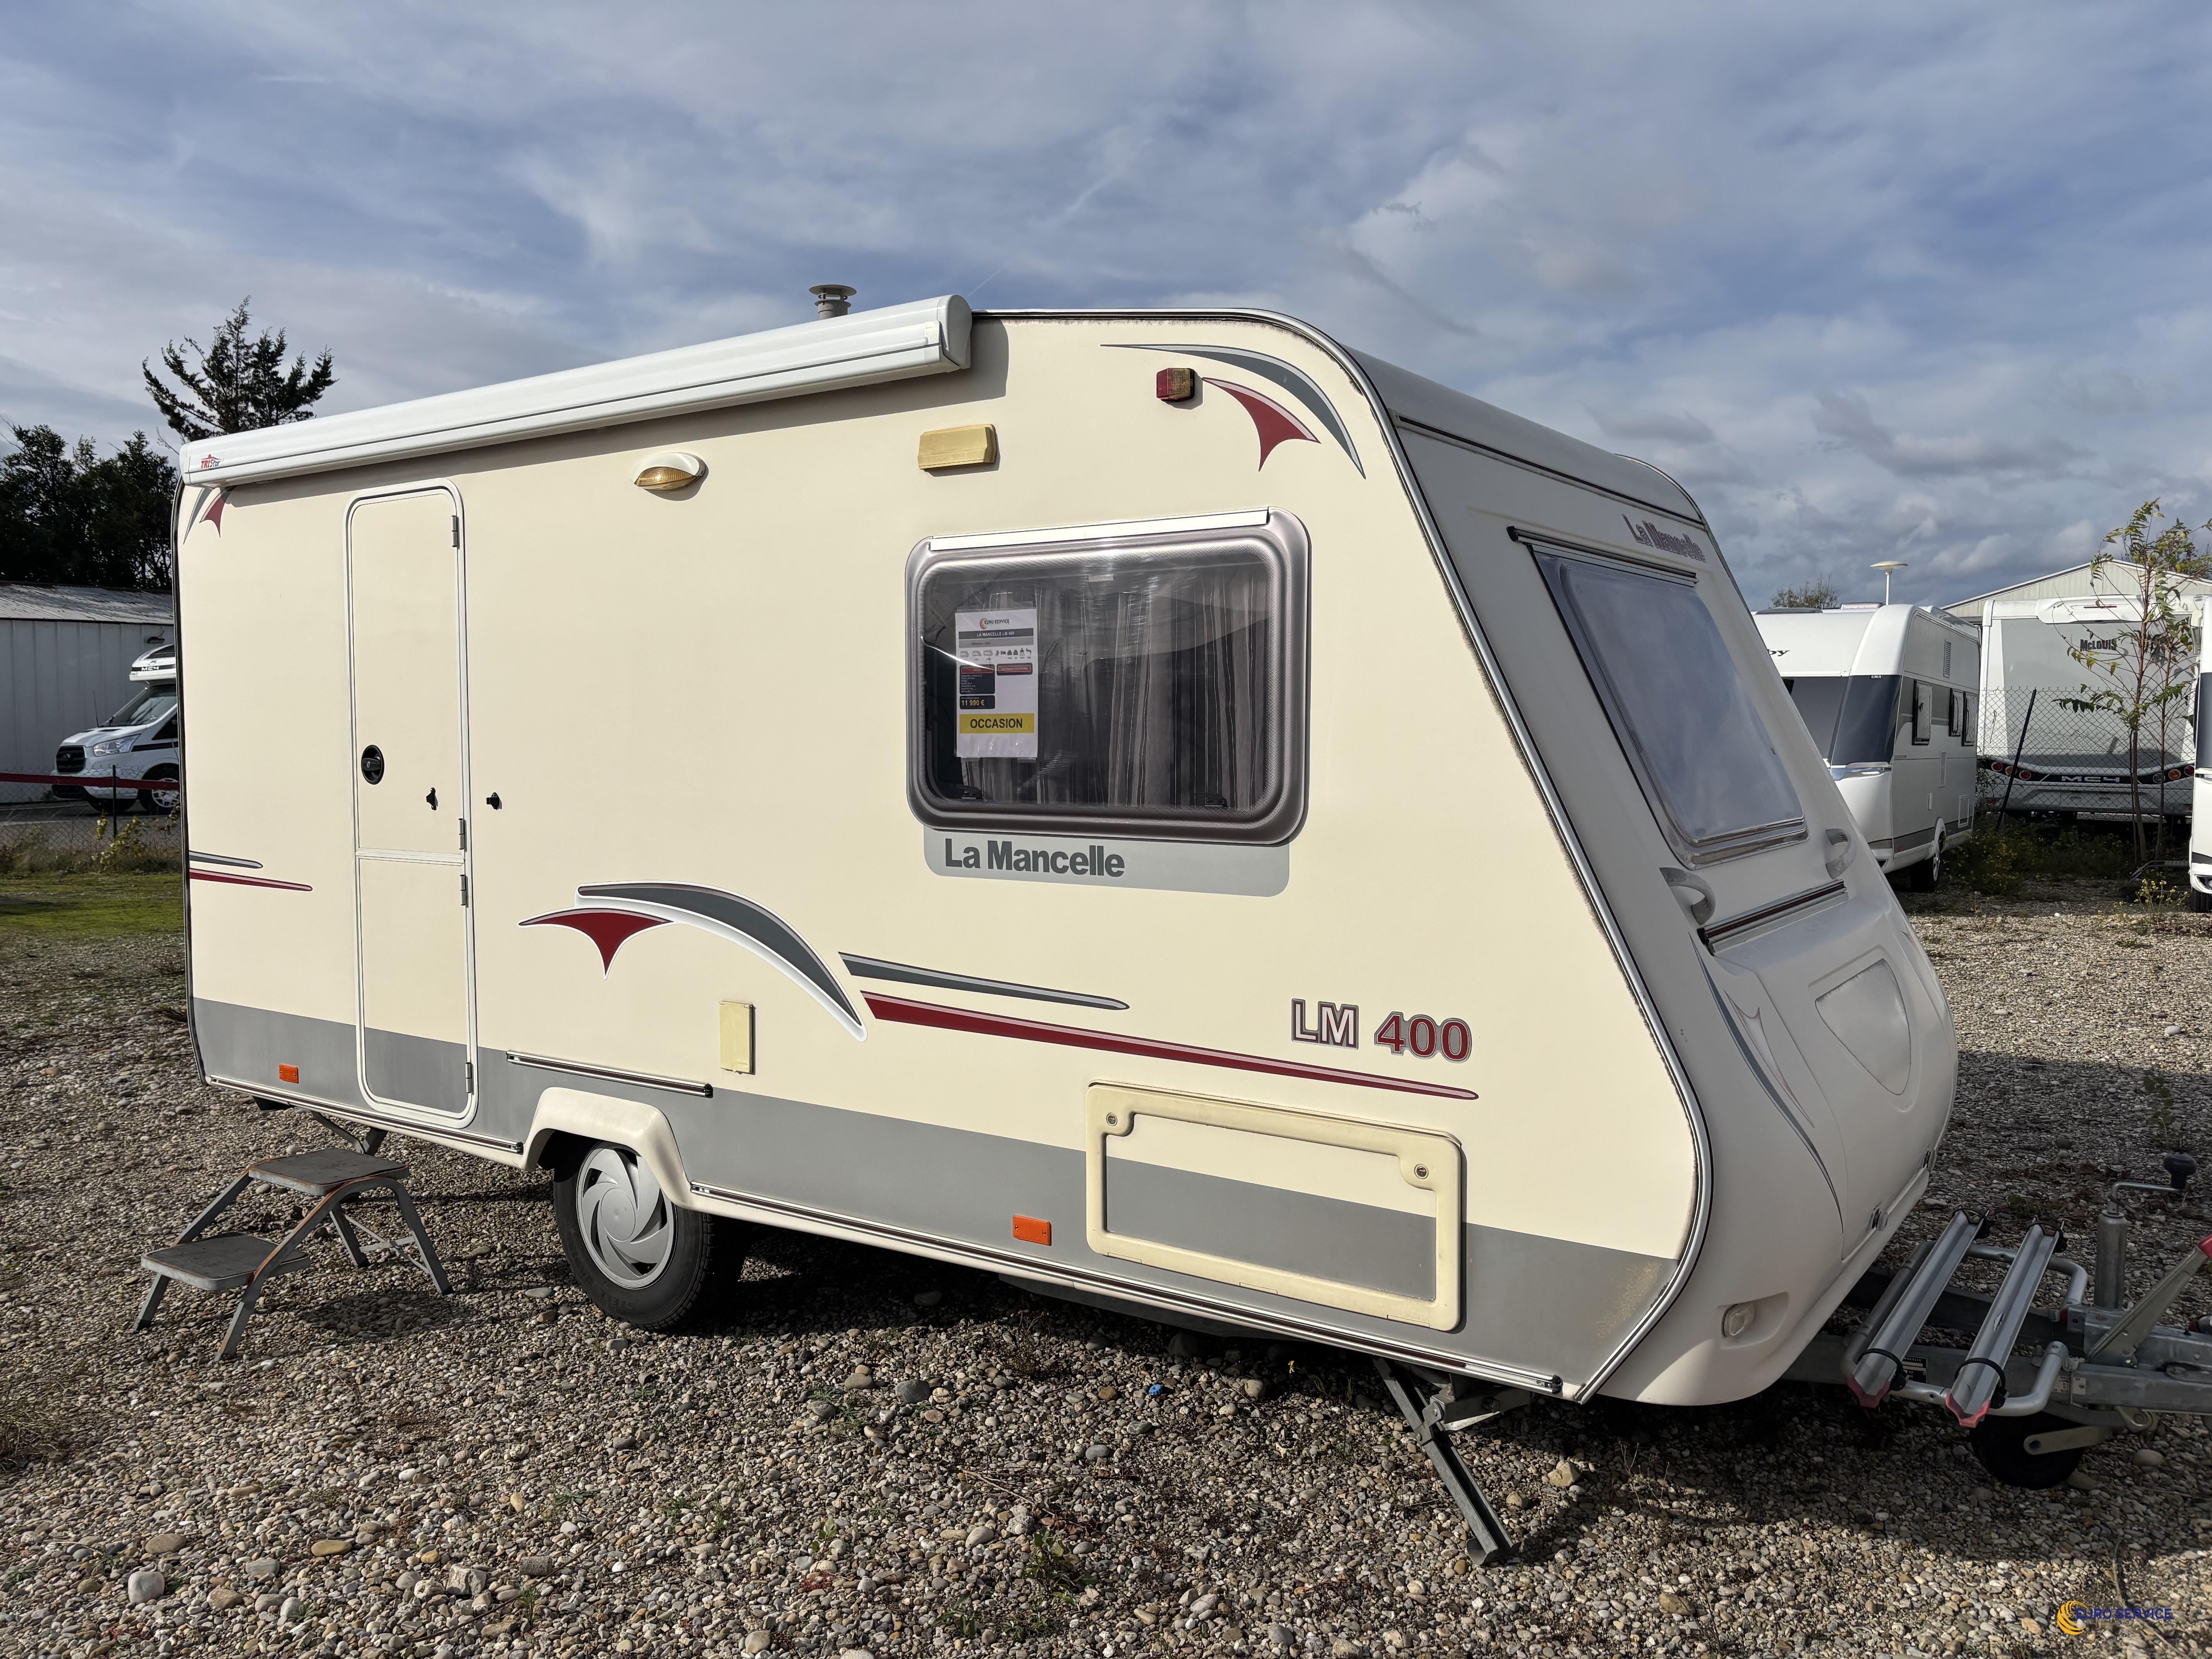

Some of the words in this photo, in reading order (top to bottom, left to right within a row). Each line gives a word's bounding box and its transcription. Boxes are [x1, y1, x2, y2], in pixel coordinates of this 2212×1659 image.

[1622, 514, 1654, 547] La
[1642, 520, 1707, 563] Mancelle
[970, 718, 1023, 728] OCCASION
[945, 838, 980, 869] La
[988, 840, 1125, 878] Mancelle
[1291, 998, 1358, 1050] LM
[1374, 1011, 1472, 1063] 400
